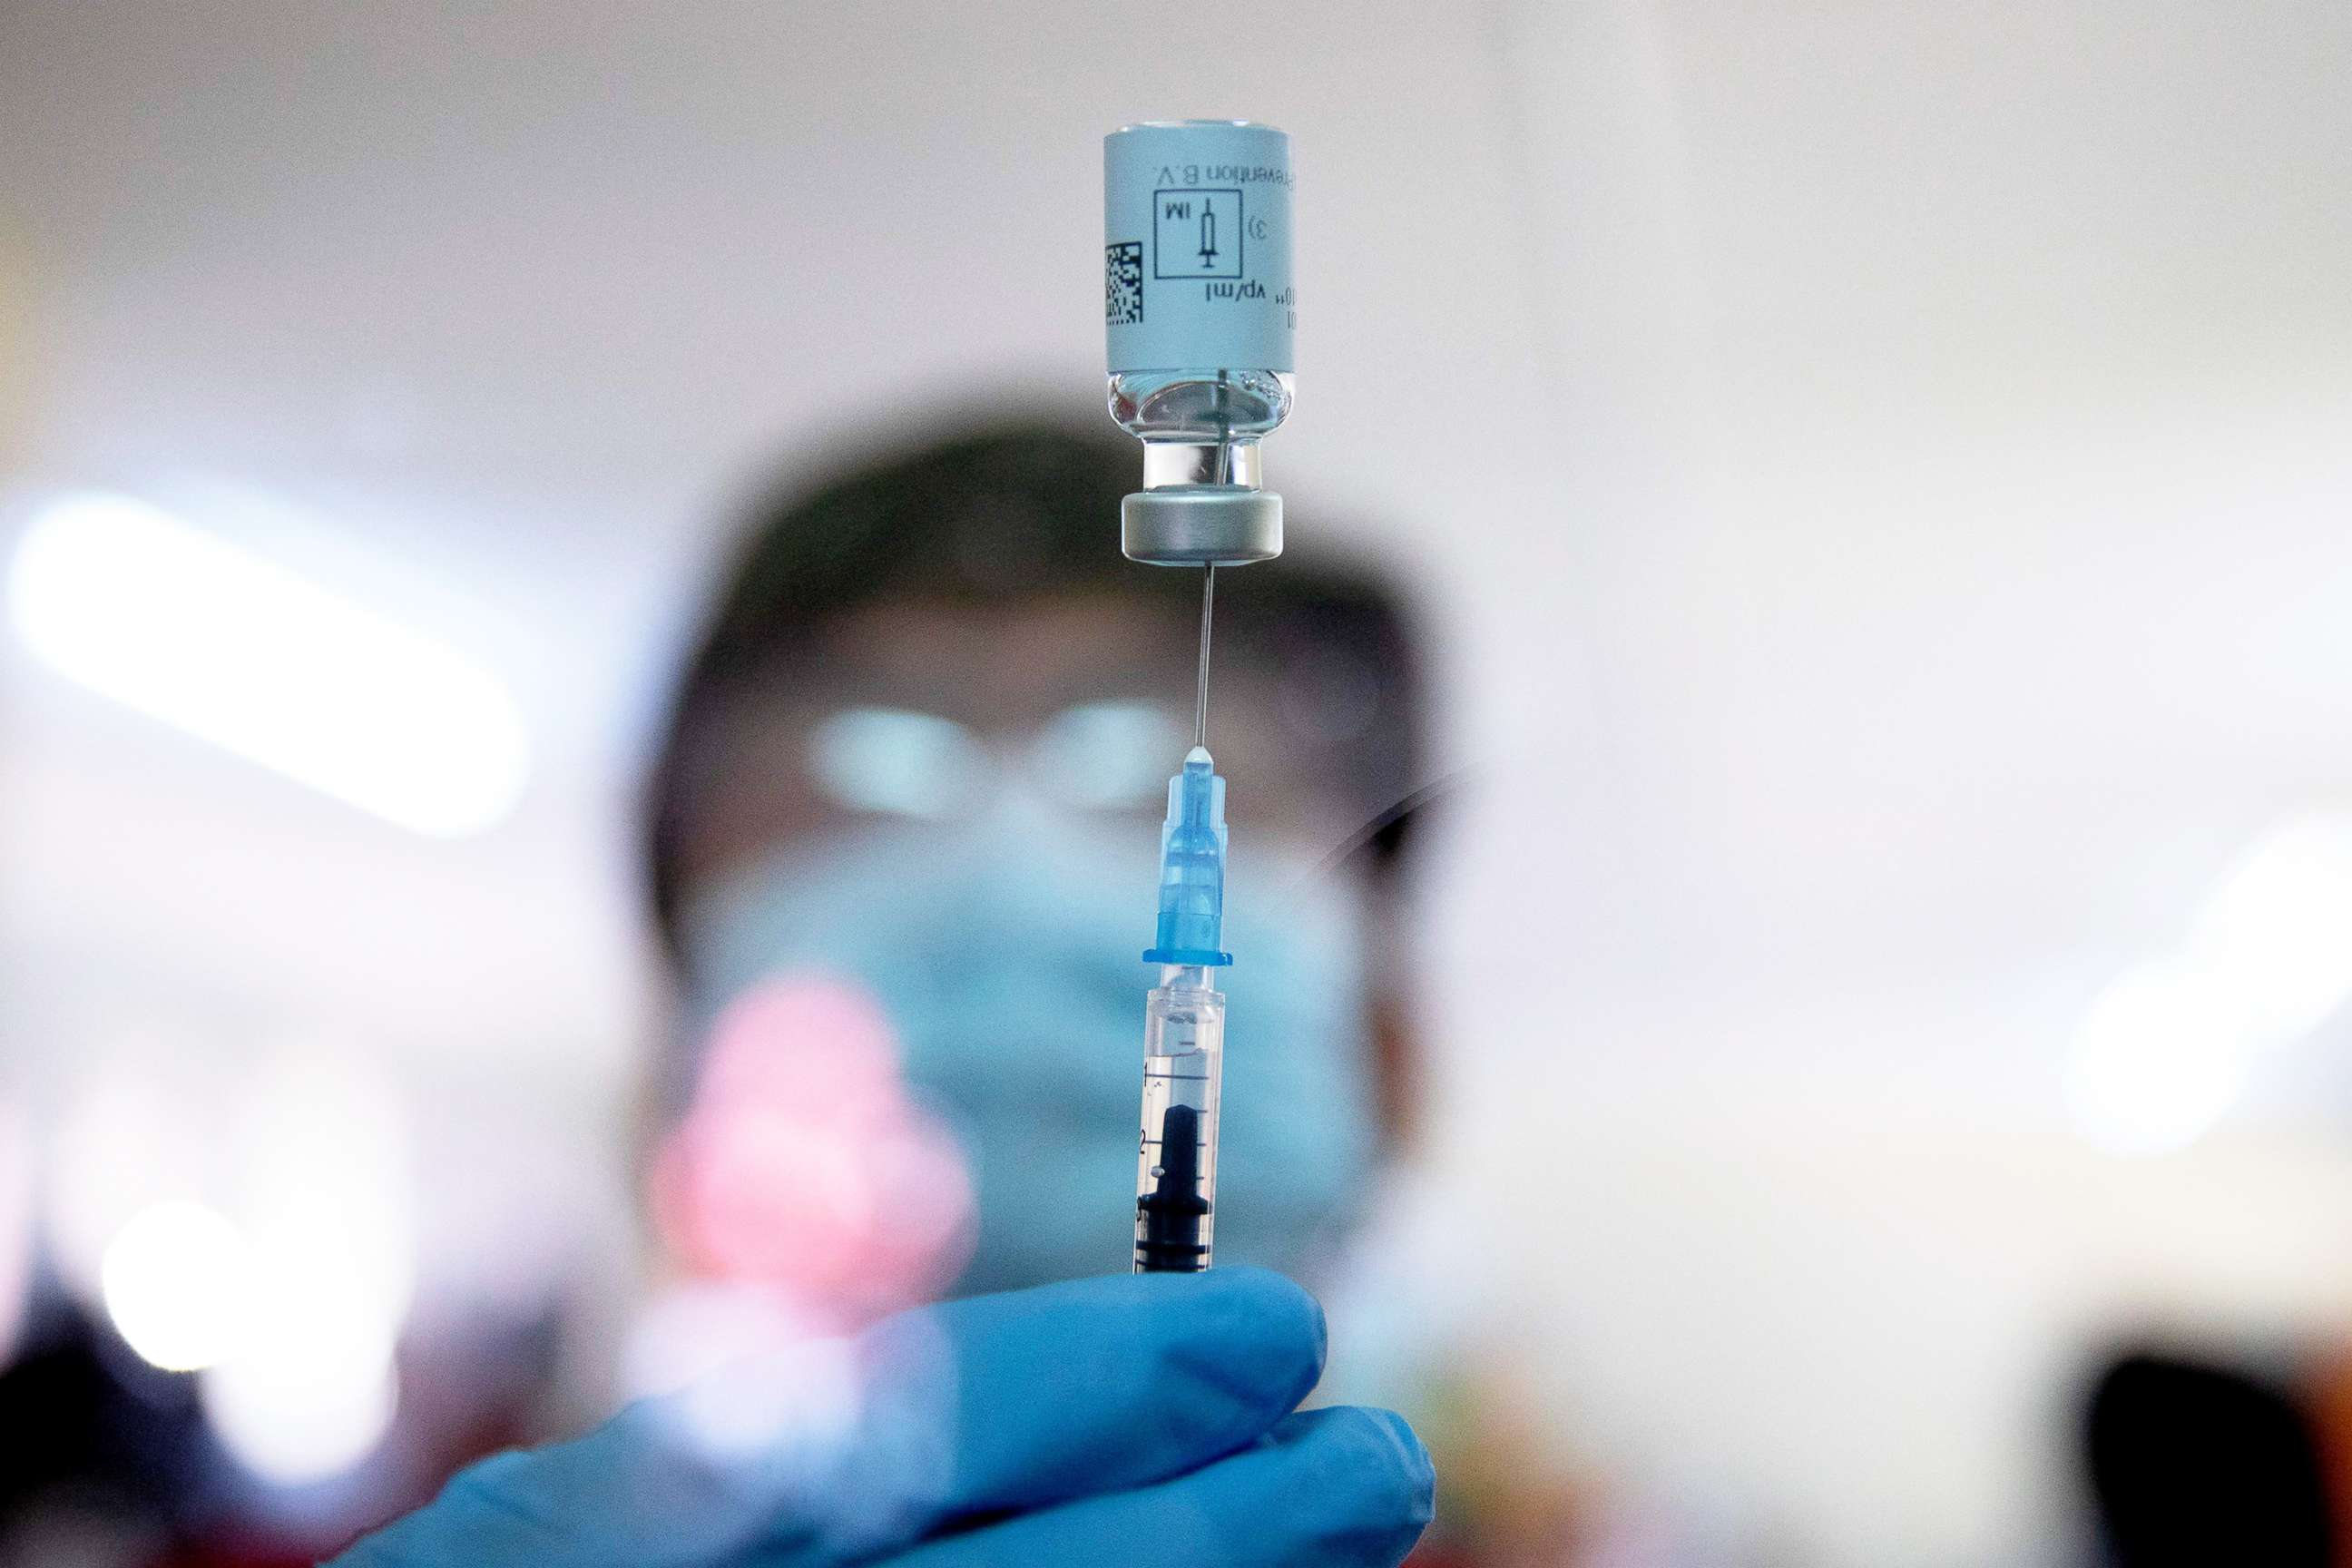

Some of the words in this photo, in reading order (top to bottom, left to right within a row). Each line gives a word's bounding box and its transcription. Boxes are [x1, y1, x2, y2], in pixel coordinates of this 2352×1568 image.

[1152, 165, 1198, 185] B.V.
[1167, 202, 1191, 220] IM
[1206, 280, 1266, 301] vp/ml
[1139, 1129, 1146, 1154] 2
